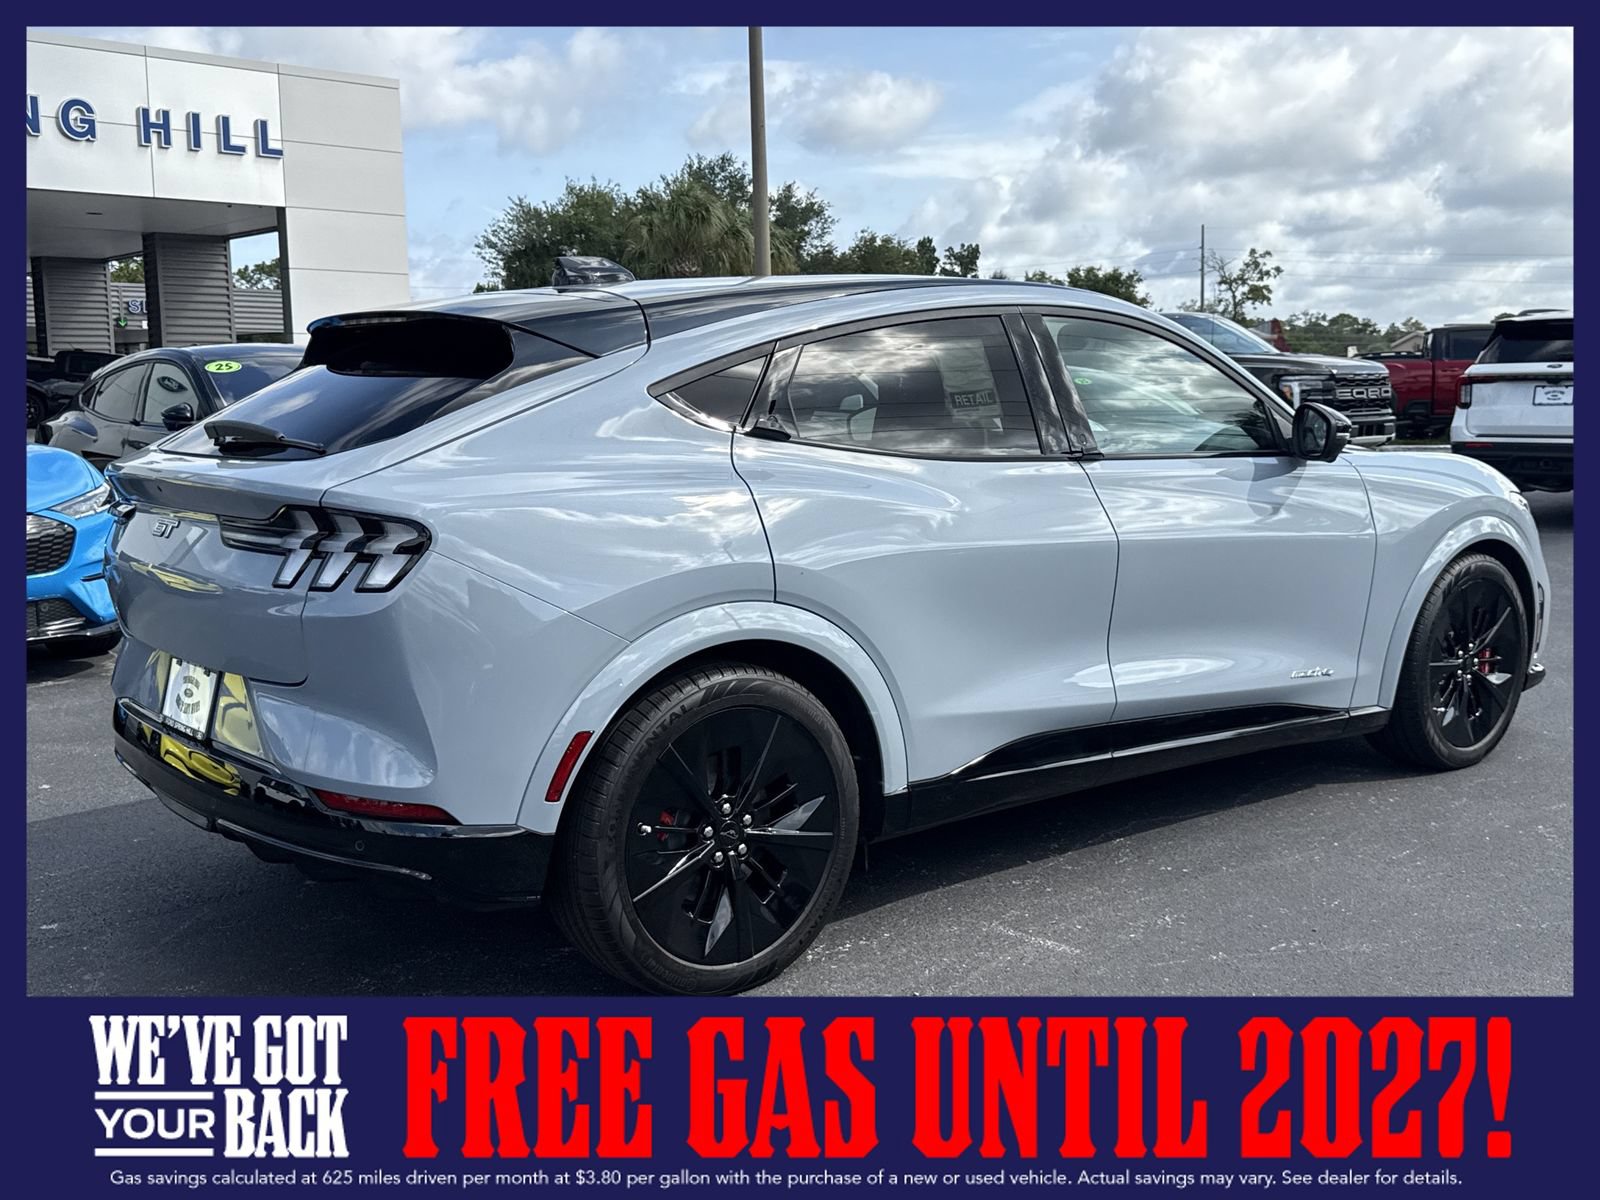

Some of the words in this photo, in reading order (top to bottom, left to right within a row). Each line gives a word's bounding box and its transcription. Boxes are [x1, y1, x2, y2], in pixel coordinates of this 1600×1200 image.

[136, 105, 284, 158] HILL
[215, 362, 234, 371] 25
[954, 391, 993, 406] RETAIL
[1335, 387, 1392, 400] FORD
[152, 518, 181, 539] GT
